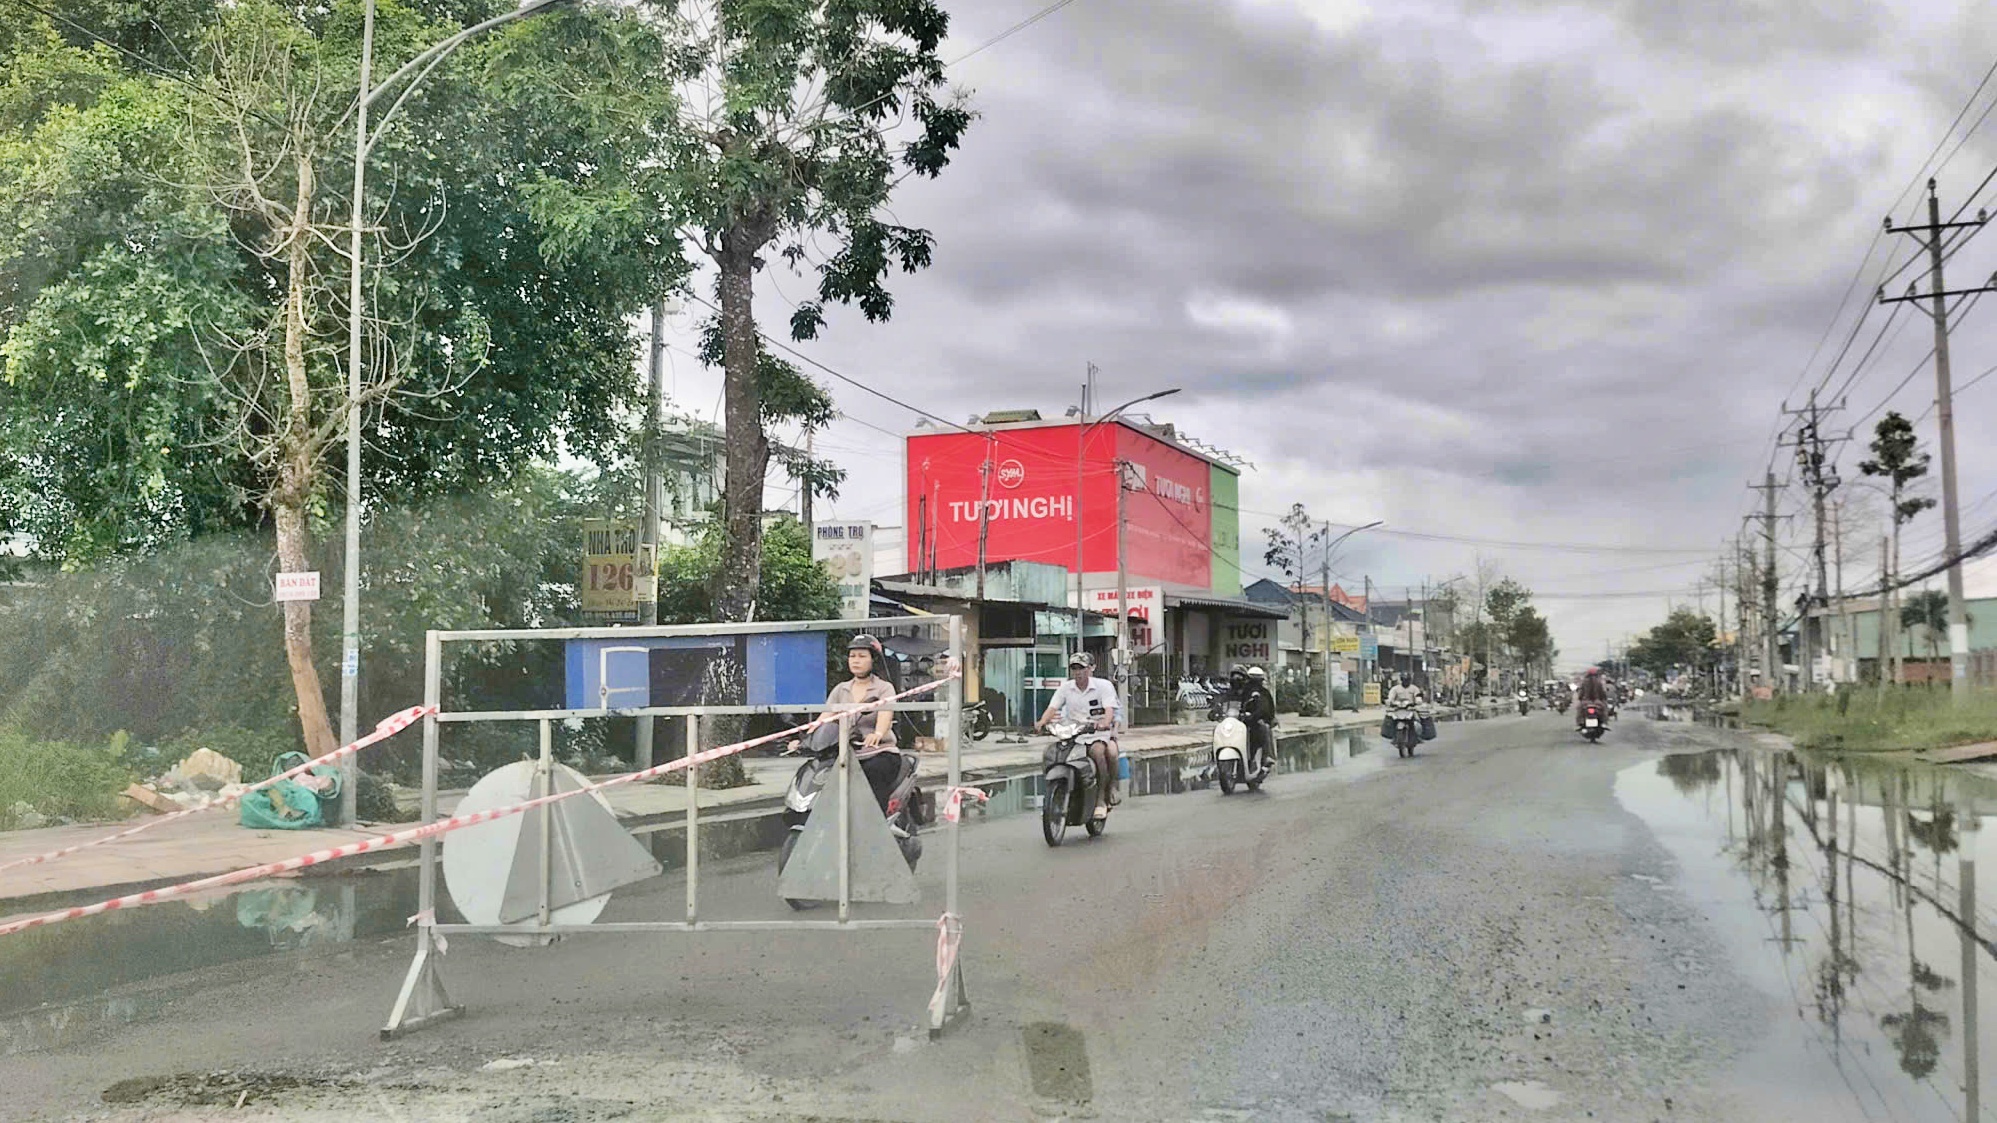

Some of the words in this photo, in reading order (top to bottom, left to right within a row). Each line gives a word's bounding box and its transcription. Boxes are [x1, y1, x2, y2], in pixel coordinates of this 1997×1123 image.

[999, 467, 1024, 482] SYM
[949, 499, 1009, 522] TƯƠI
[1013, 495, 1073, 521] NGHỊ
[817, 525, 845, 539] PHÒNG
[847, 525, 864, 540] TRỌ
[588, 525, 612, 555] NHÀ
[614, 528, 636, 559] TRỌ
[280, 577, 297, 588] BÁN
[589, 563, 634, 591] 126
[1228, 623, 1267, 640] TƯƠI
[1225, 643, 1269, 661] NGHỊ
